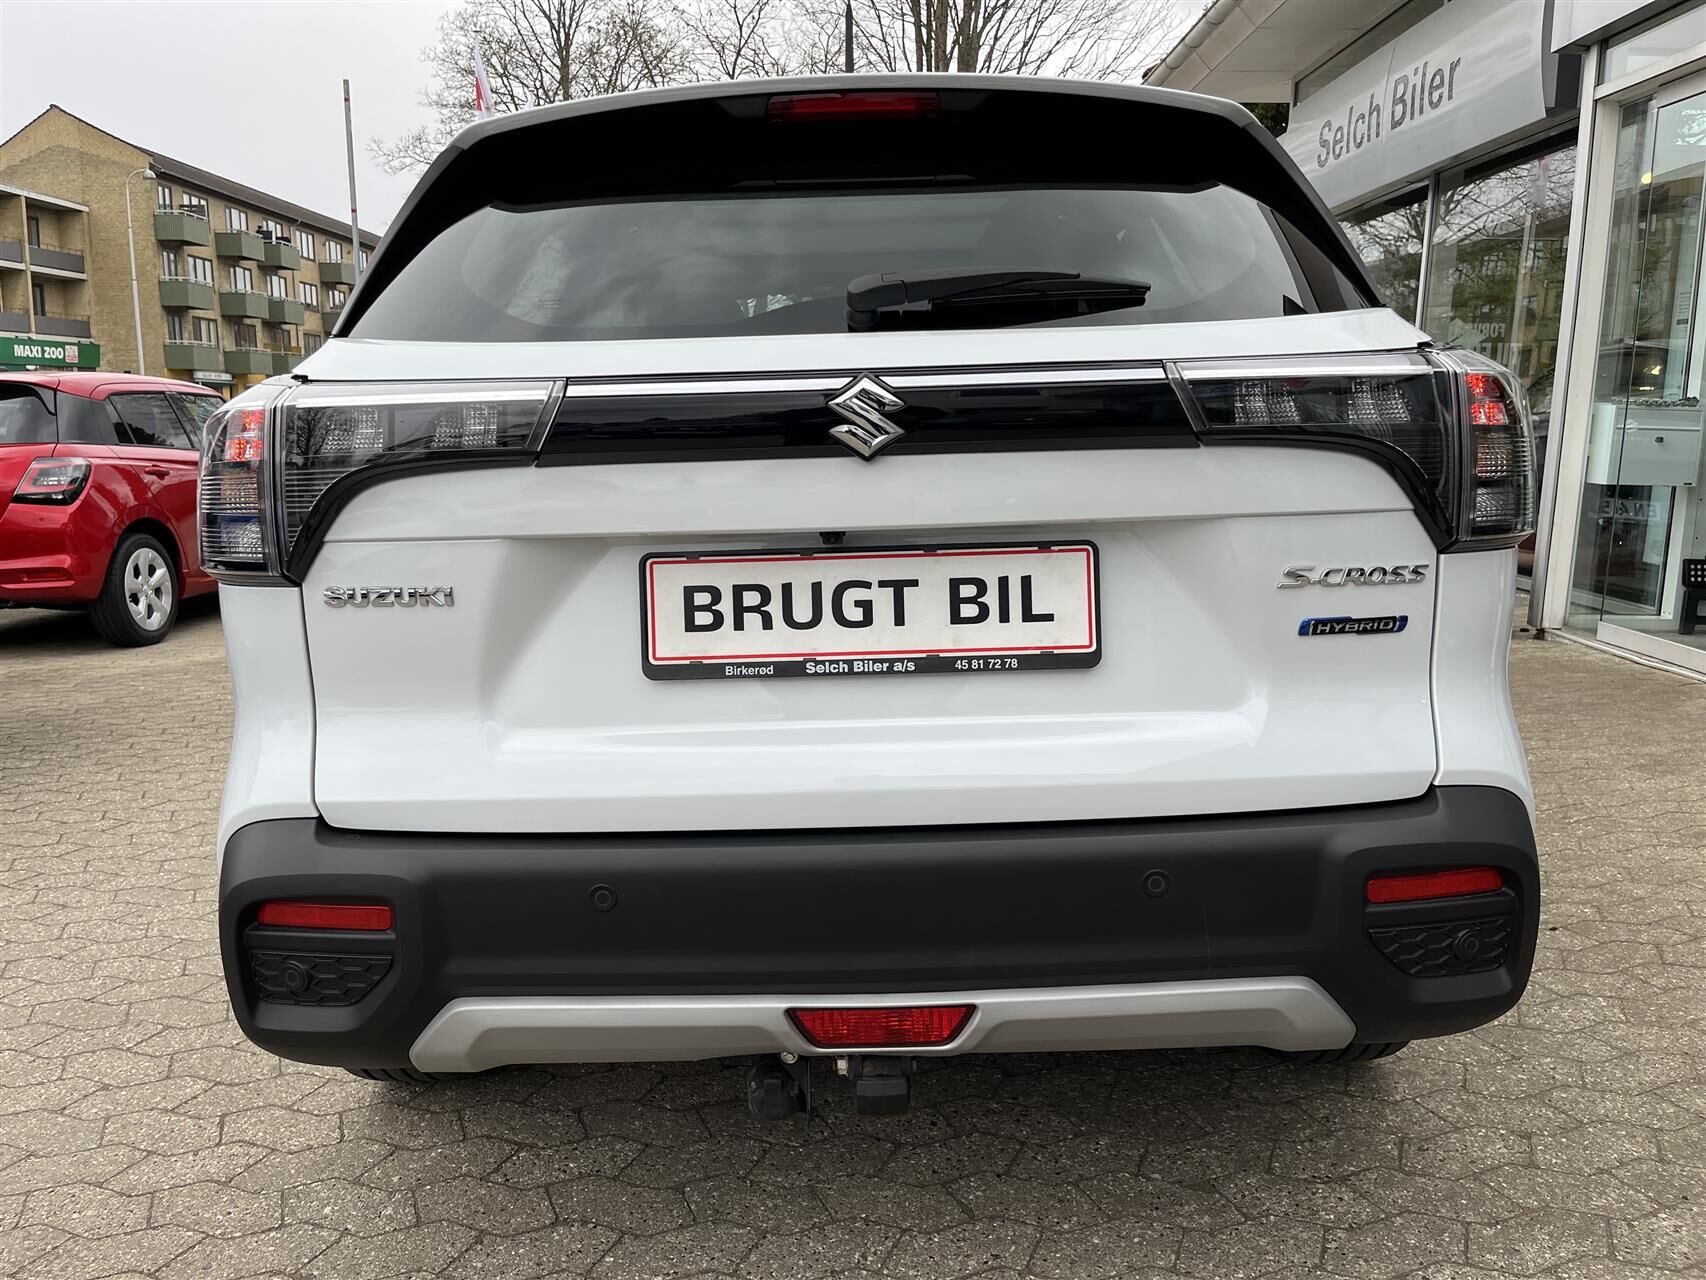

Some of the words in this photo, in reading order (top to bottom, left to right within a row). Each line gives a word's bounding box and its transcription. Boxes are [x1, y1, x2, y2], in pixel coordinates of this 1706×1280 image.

[1317, 93, 1381, 168] Selch
[1390, 57, 1461, 131] Biler
[13, 344, 42, 358] MAXI
[43, 347, 64, 359] ZOO
[323, 586, 454, 608] SUZUKI
[683, 579, 920, 633] BRUGT
[947, 574, 1056, 626] BIL
[725, 665, 774, 676] Birkerød
[805, 661, 849, 674] Selch
[853, 659, 889, 672] Biler
[893, 660, 916, 672] a/s
[954, 660, 969, 670] 45
[971, 660, 984, 669] 81
[987, 659, 1002, 669] 72
[1004, 658, 1019, 668] 78
